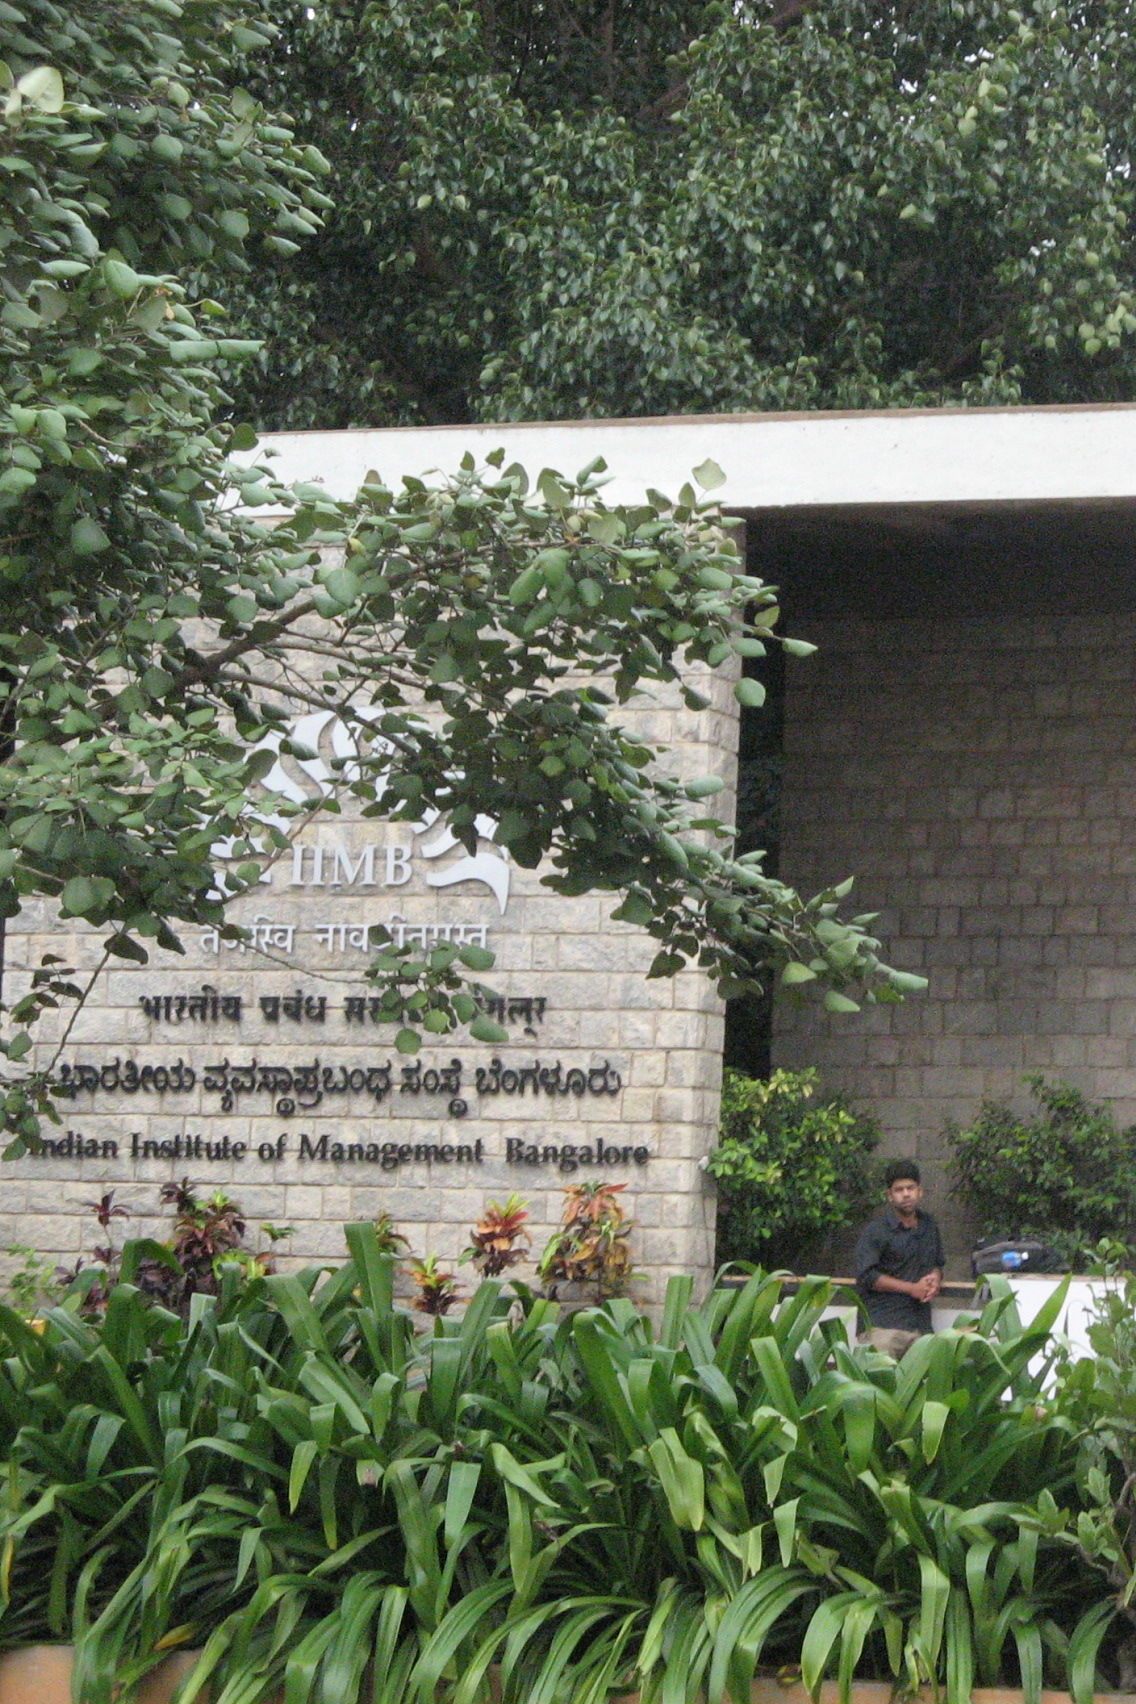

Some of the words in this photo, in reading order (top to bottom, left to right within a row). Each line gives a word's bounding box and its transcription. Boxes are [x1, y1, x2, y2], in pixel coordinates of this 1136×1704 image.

[288, 844, 413, 887] IIMB
[139, 984, 242, 1025] भारतीय
[28, 1130, 119, 1158] ndian
[130, 1131, 248, 1161] Institute
[257, 1133, 288, 1163] of
[299, 1134, 484, 1171] Management
[504, 1137, 649, 1173] Bangalore
